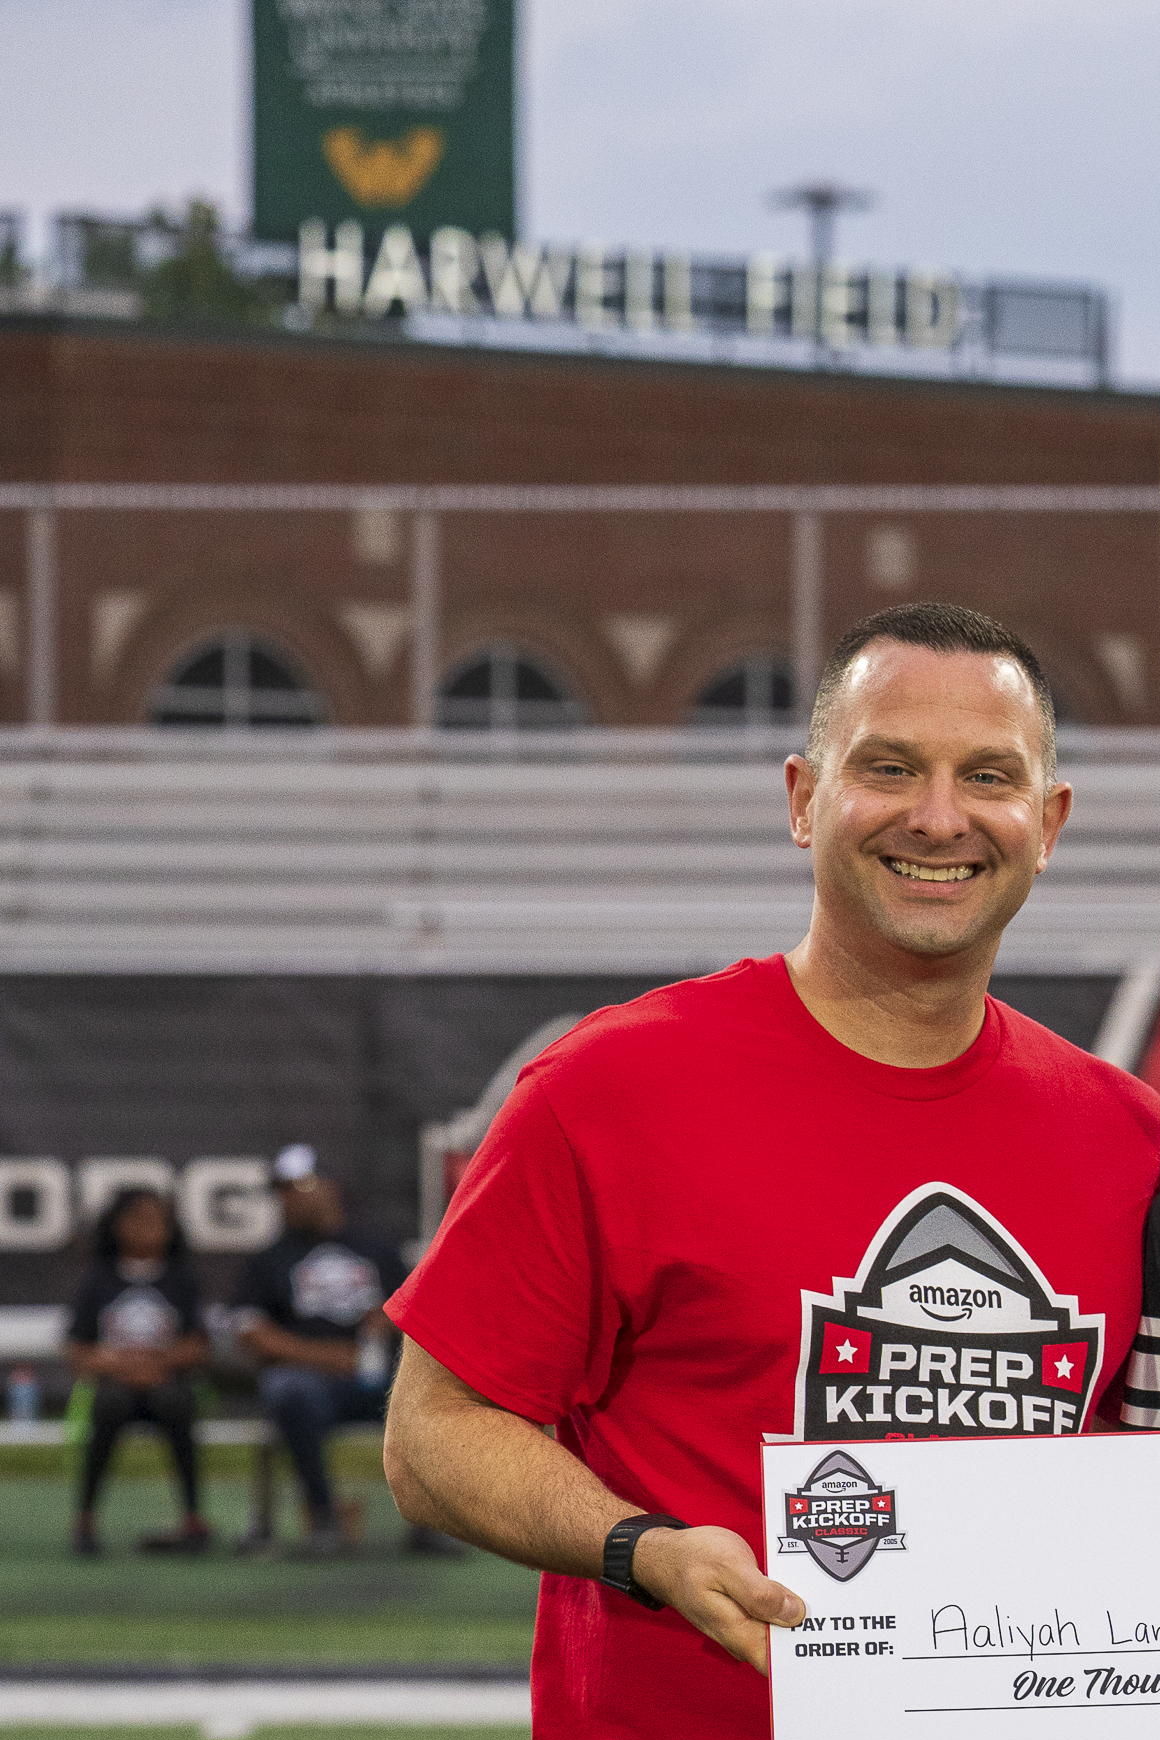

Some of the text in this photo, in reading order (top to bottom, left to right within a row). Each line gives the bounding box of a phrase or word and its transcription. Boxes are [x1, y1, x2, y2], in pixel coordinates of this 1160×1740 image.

[298, 217, 960, 350] HARWELL FIELD
[909, 1284, 1002, 1309] amazon
[879, 1343, 1034, 1388] PREP
[826, 1384, 1077, 1435] KICKOFF
[821, 1480, 858, 1489] amazon
[811, 1499, 871, 1514] PREP
[792, 1512, 890, 1529] KICKOFF
[814, 1527, 868, 1537] CLASSIC
[830, 1616, 855, 1631] TO
[859, 1615, 897, 1630] THE
[931, 1604, 1080, 1661] Aaliyah
[795, 1641, 894, 1658] ORDER OF:
[1013, 1670, 1076, 1700] One
